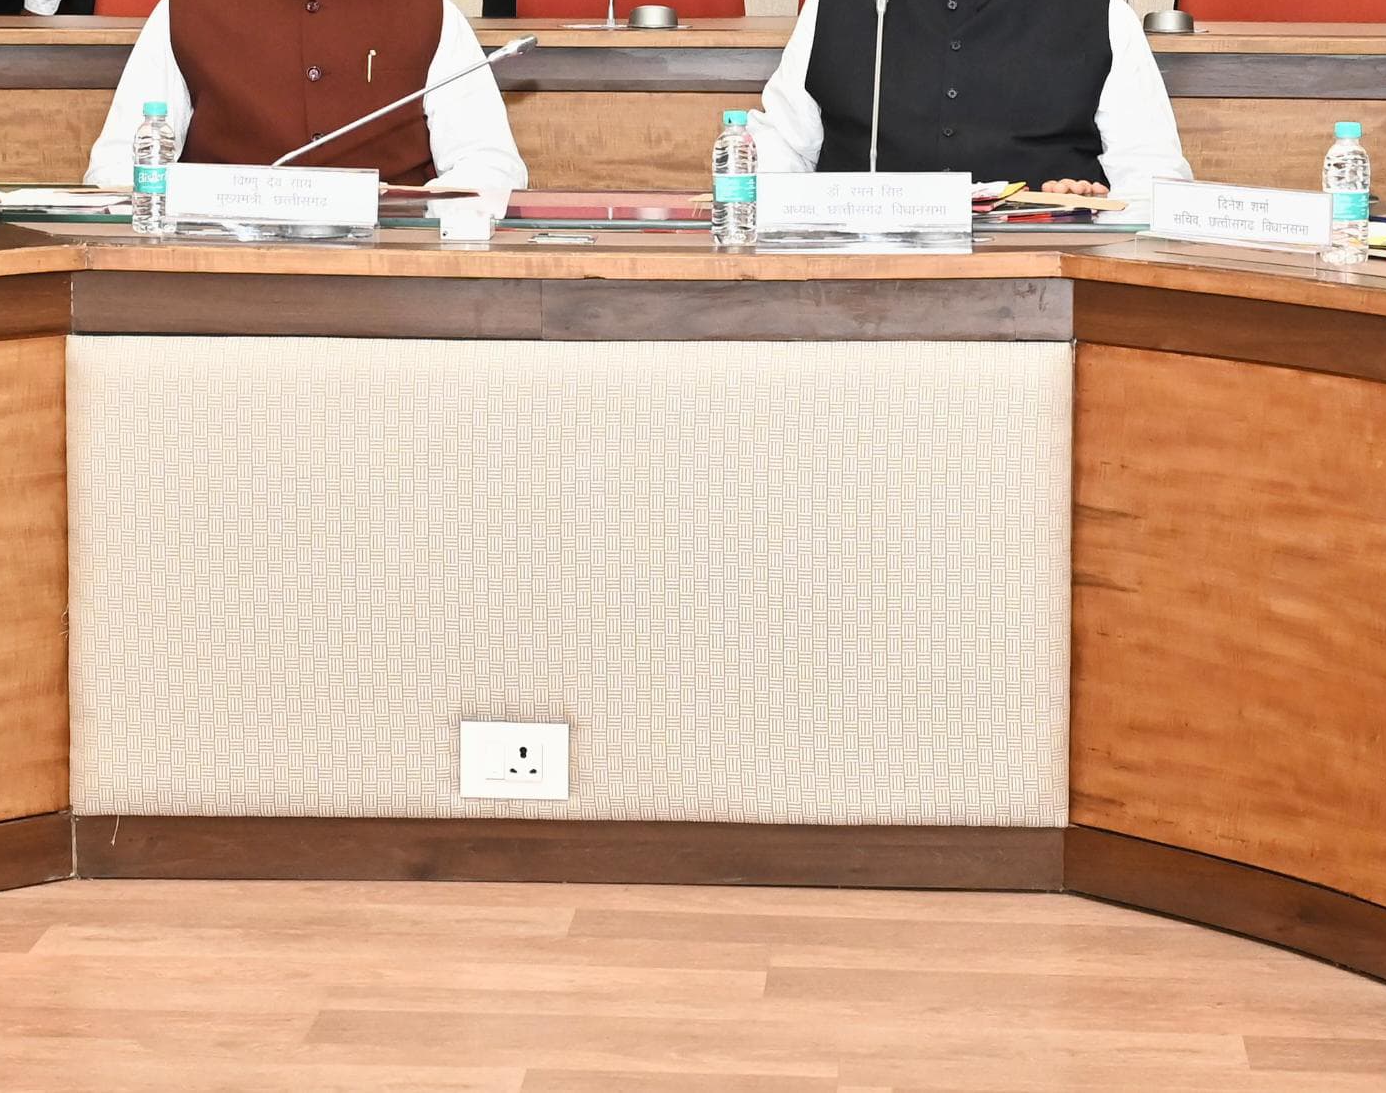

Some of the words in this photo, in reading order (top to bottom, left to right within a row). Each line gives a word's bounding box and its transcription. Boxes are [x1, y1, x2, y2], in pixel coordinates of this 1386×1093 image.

[1217, 195, 1244, 211] दिनेश
[1250, 198, 1270, 215] शर्मा
[1262, 217, 1310, 236] विधानसभा
